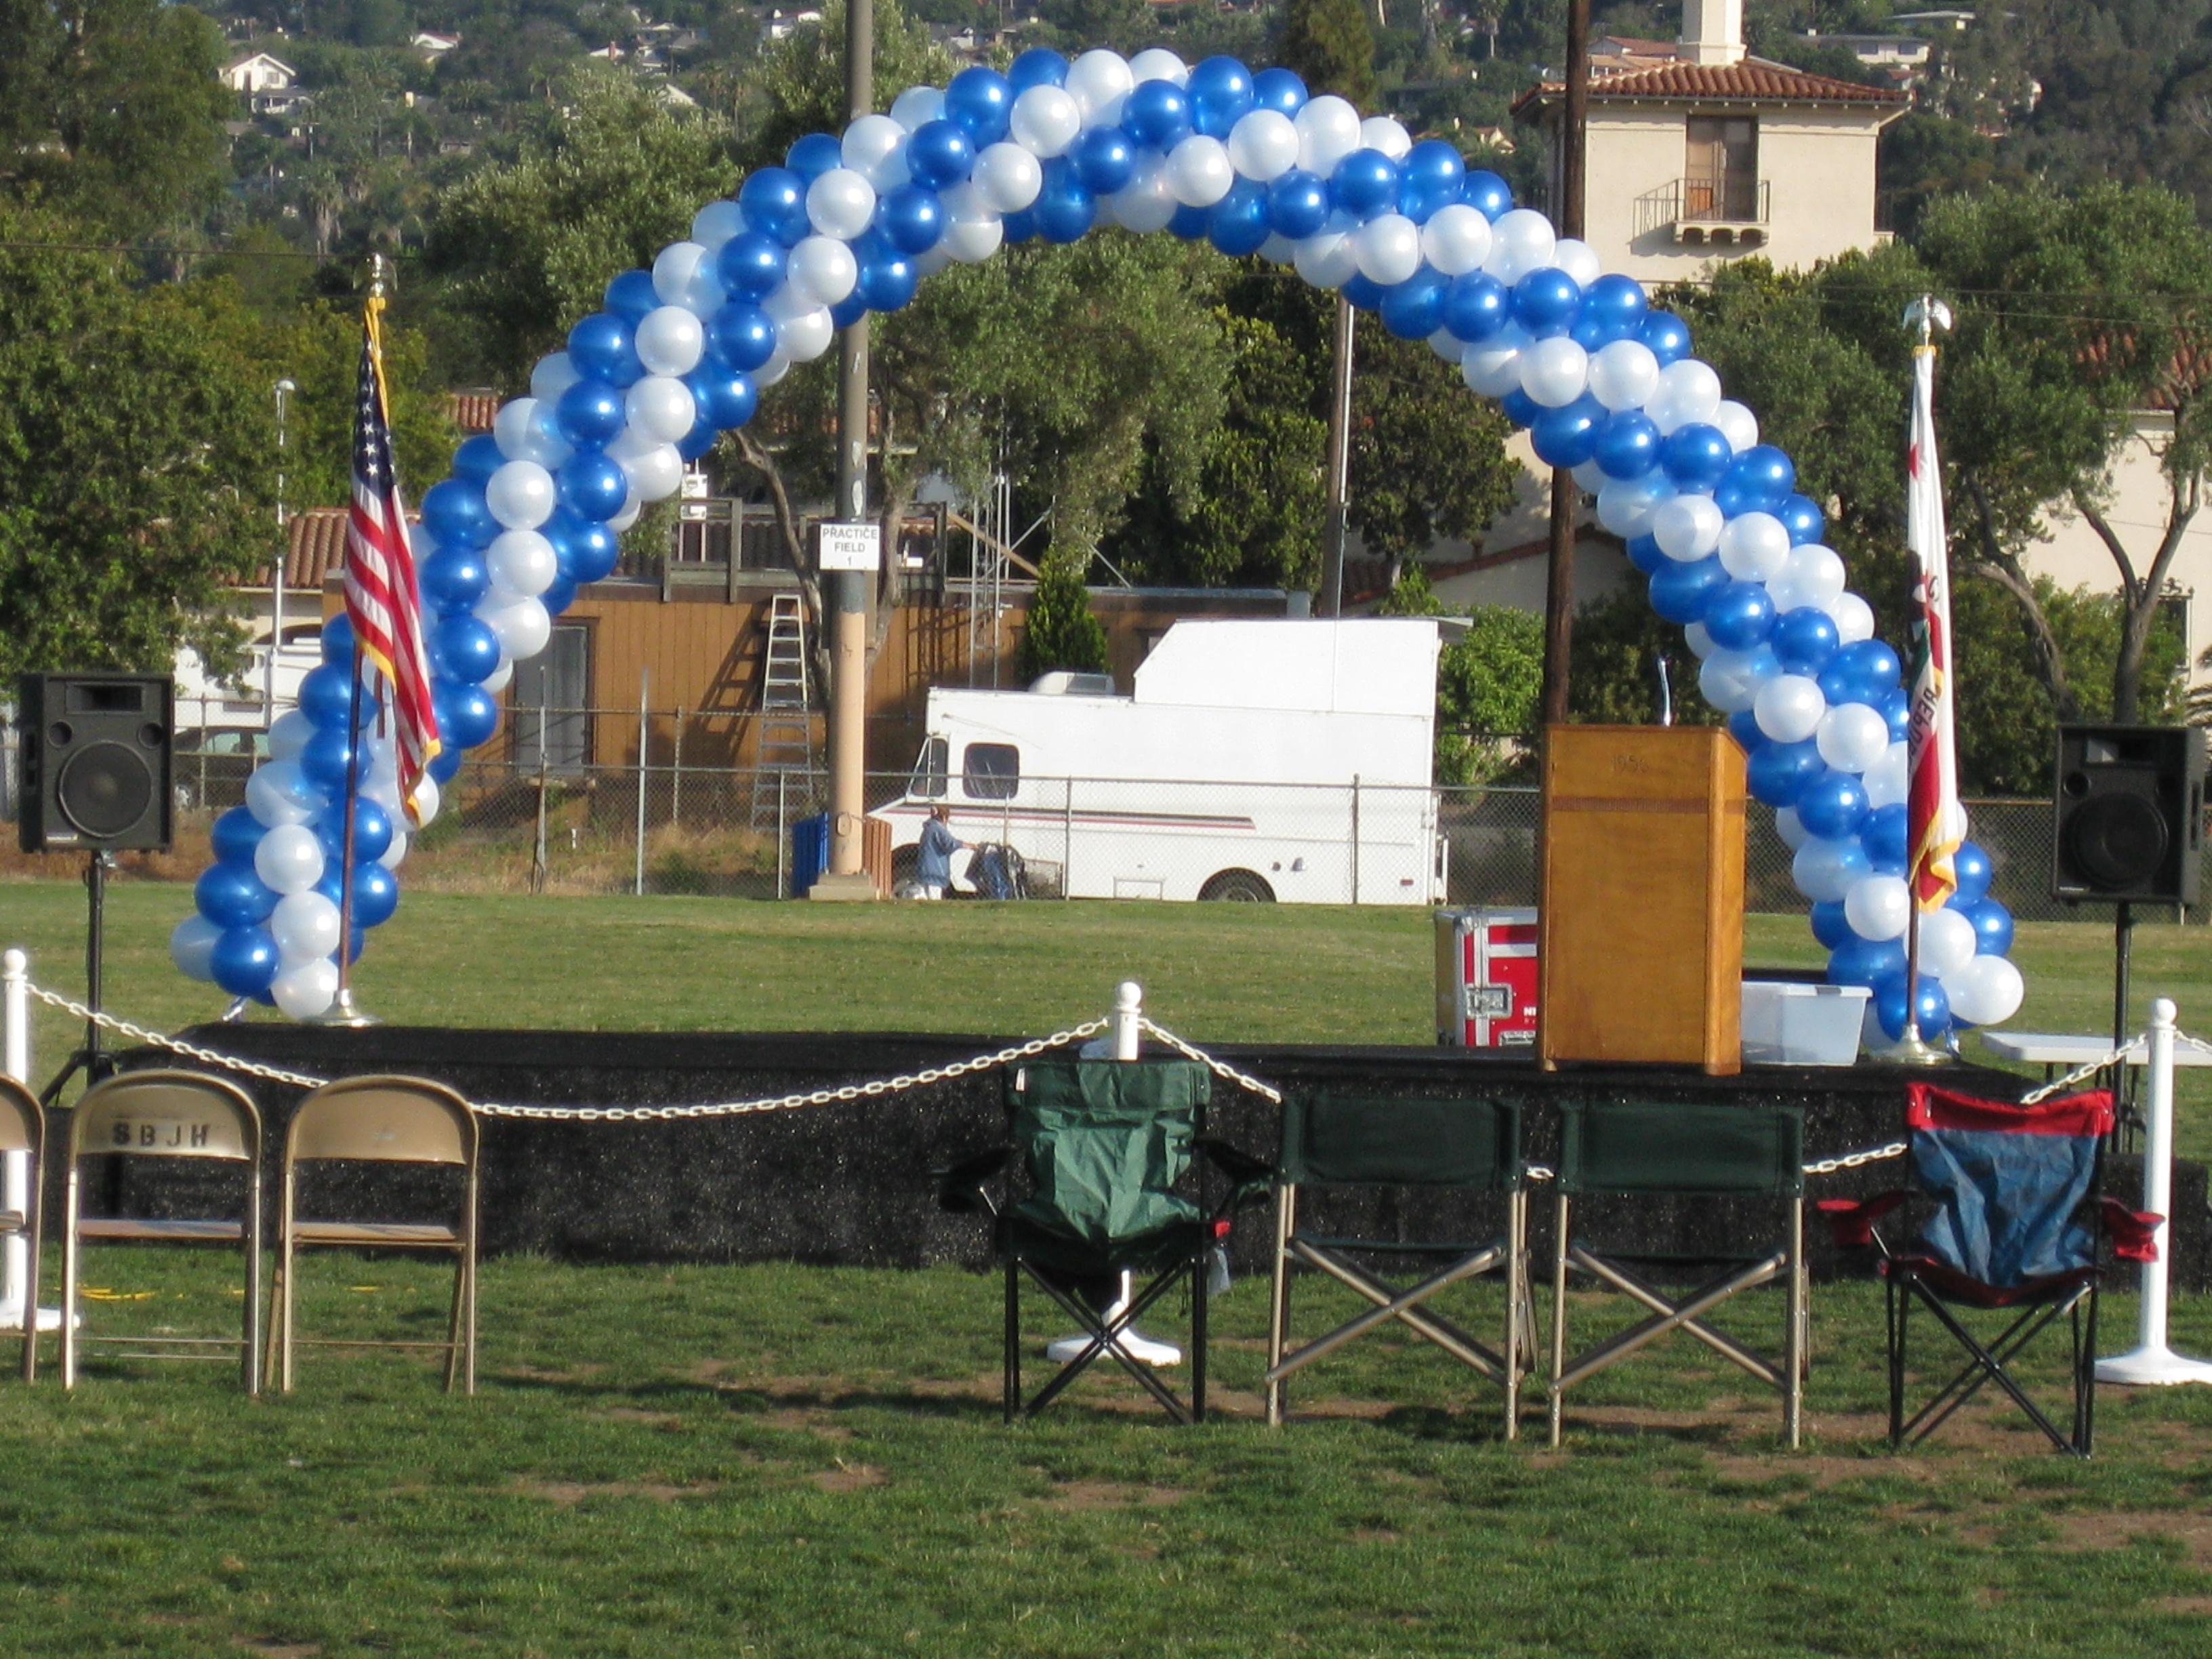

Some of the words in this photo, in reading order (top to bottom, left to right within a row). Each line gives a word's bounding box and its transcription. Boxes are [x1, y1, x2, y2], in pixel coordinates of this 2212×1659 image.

[823, 527, 877, 539] PRACTICE
[834, 541, 865, 552] FIELD
[846, 556, 853, 566] 1
[1613, 754, 1650, 773] 1956
